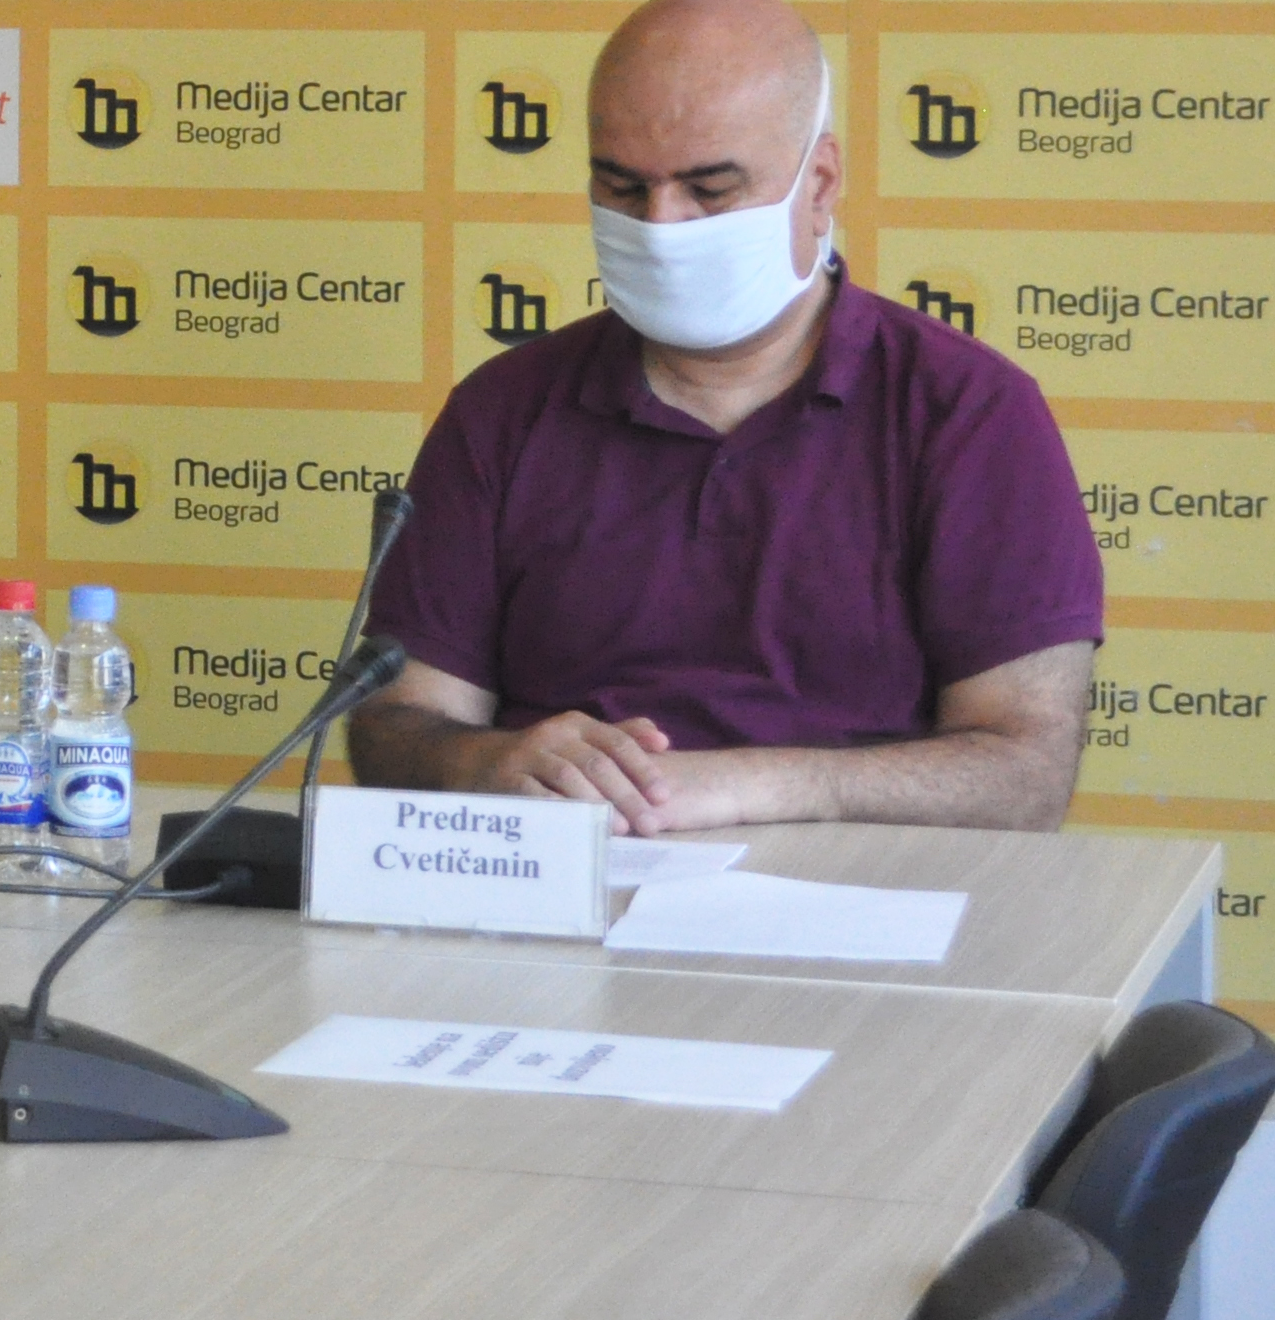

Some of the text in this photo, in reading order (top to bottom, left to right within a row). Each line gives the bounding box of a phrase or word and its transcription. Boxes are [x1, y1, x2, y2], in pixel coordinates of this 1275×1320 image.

[176, 80, 408, 119] Medija Centar
[1018, 87, 1271, 127] Medija Centar
[176, 120, 281, 150] Beograd
[1018, 128, 1133, 160] Beograd
[1016, 284, 1270, 325] Medija Centar
[1017, 326, 1132, 357] Beograd
[174, 457, 288, 497] Medija
[174, 497, 279, 528] Beograd
[58, 745, 130, 764] MINAQUA
[395, 801, 522, 843] Predrag
[373, 842, 541, 879] Cvetičanin
